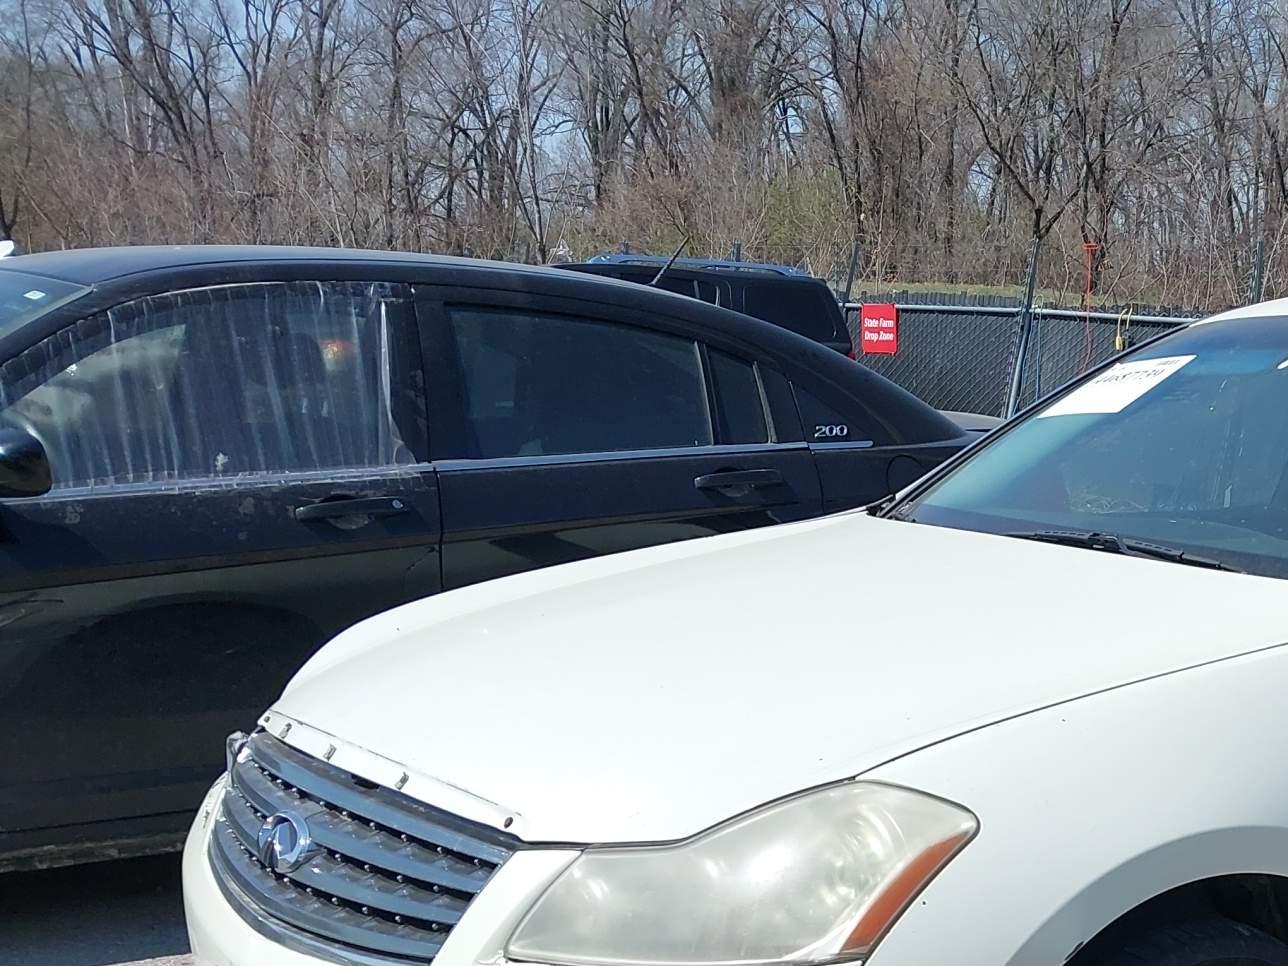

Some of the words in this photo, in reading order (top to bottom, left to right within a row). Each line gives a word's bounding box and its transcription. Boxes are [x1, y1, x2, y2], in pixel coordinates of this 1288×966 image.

[864, 318, 879, 328] State
[879, 318, 894, 328] Farm
[864, 331, 879, 343] Drop
[878, 331, 894, 341] Zone
[814, 424, 848, 438] 200
